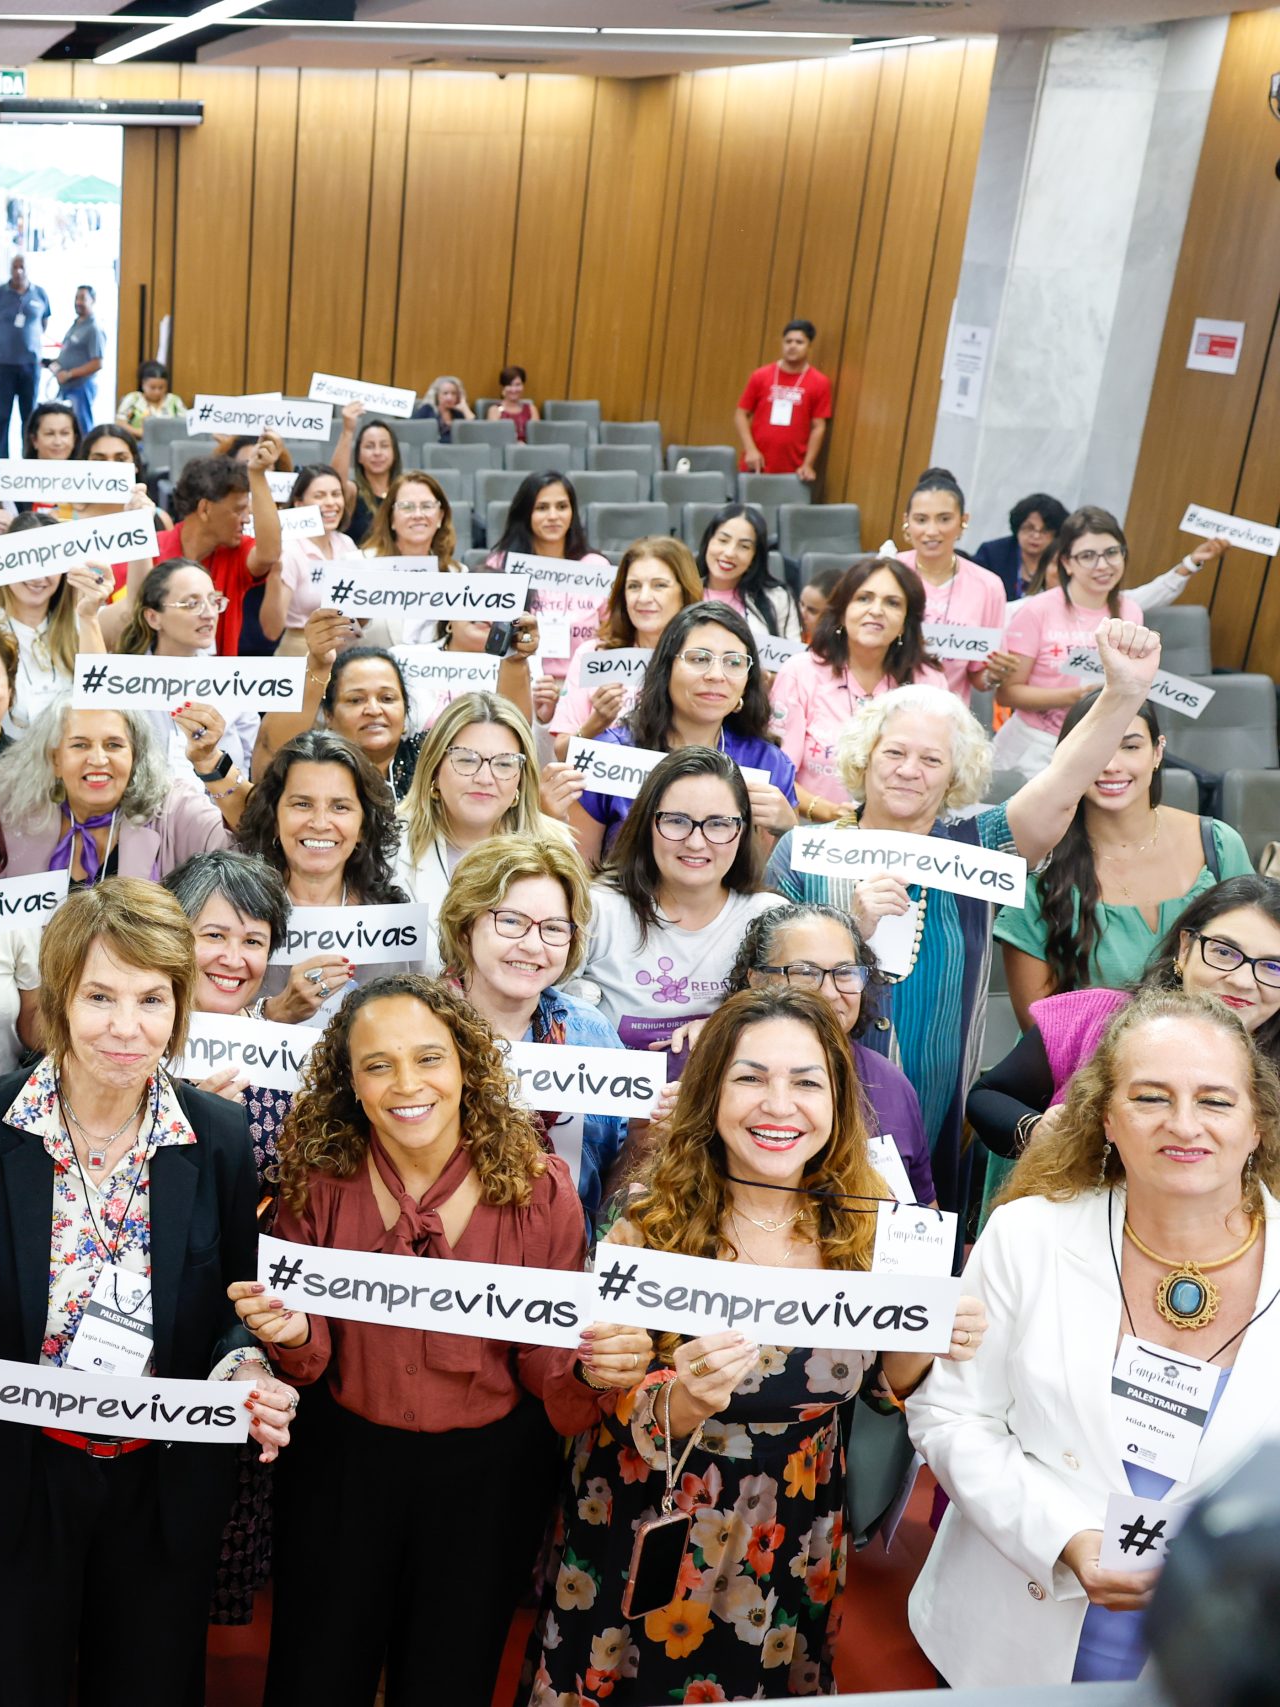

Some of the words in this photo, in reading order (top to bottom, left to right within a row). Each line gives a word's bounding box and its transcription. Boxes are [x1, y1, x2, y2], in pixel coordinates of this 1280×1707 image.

[316, 382, 408, 410] #semprevivas
[199, 403, 325, 430] #semprevivas
[330, 578, 516, 611] #semprevivas
[82, 665, 294, 701] #semprevivas
[801, 838, 1016, 892] #semprevivas
[283, 920, 419, 955] previvas
[631, 1022, 665, 1030] NENHUM
[268, 1255, 579, 1328] #semprevivas
[598, 1261, 930, 1332] #semprevivas
[99, 1308, 146, 1333] PALESTRANTE
[1126, 1386, 1189, 1417] PALESTRANTE
[1125, 1415, 1147, 1429] Hilda
[1148, 1423, 1176, 1440] Morais
